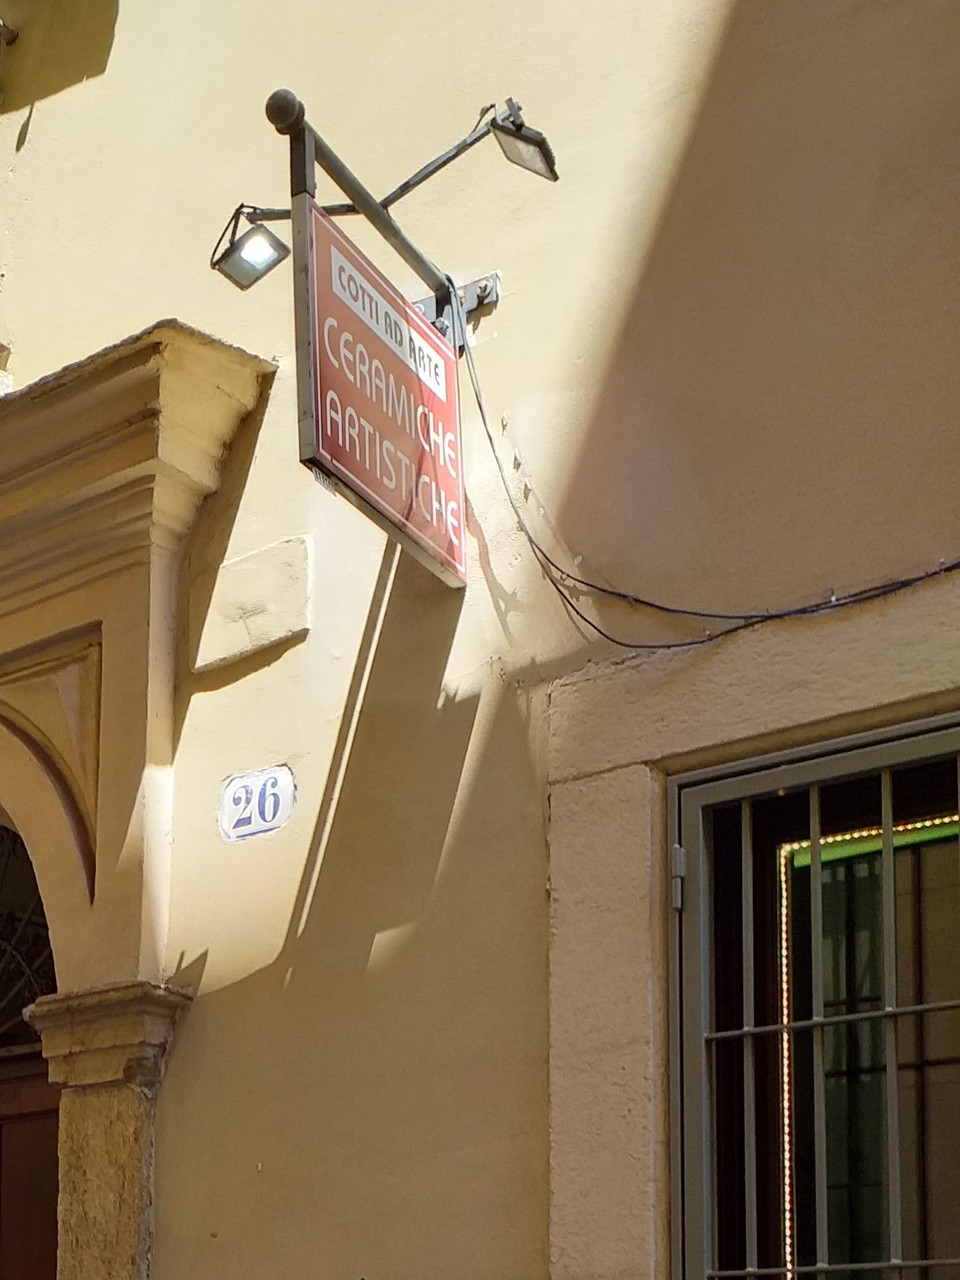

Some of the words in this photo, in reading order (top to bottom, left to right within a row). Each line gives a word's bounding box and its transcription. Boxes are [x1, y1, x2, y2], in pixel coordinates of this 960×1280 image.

[338, 264, 380, 326] COTTI
[384, 310, 404, 348] AD
[408, 335, 440, 387] ARTE
[323, 316, 457, 479] CERAMICHE
[326, 389, 460, 547] ARTISTICHE
[232, 776, 281, 830] 26
